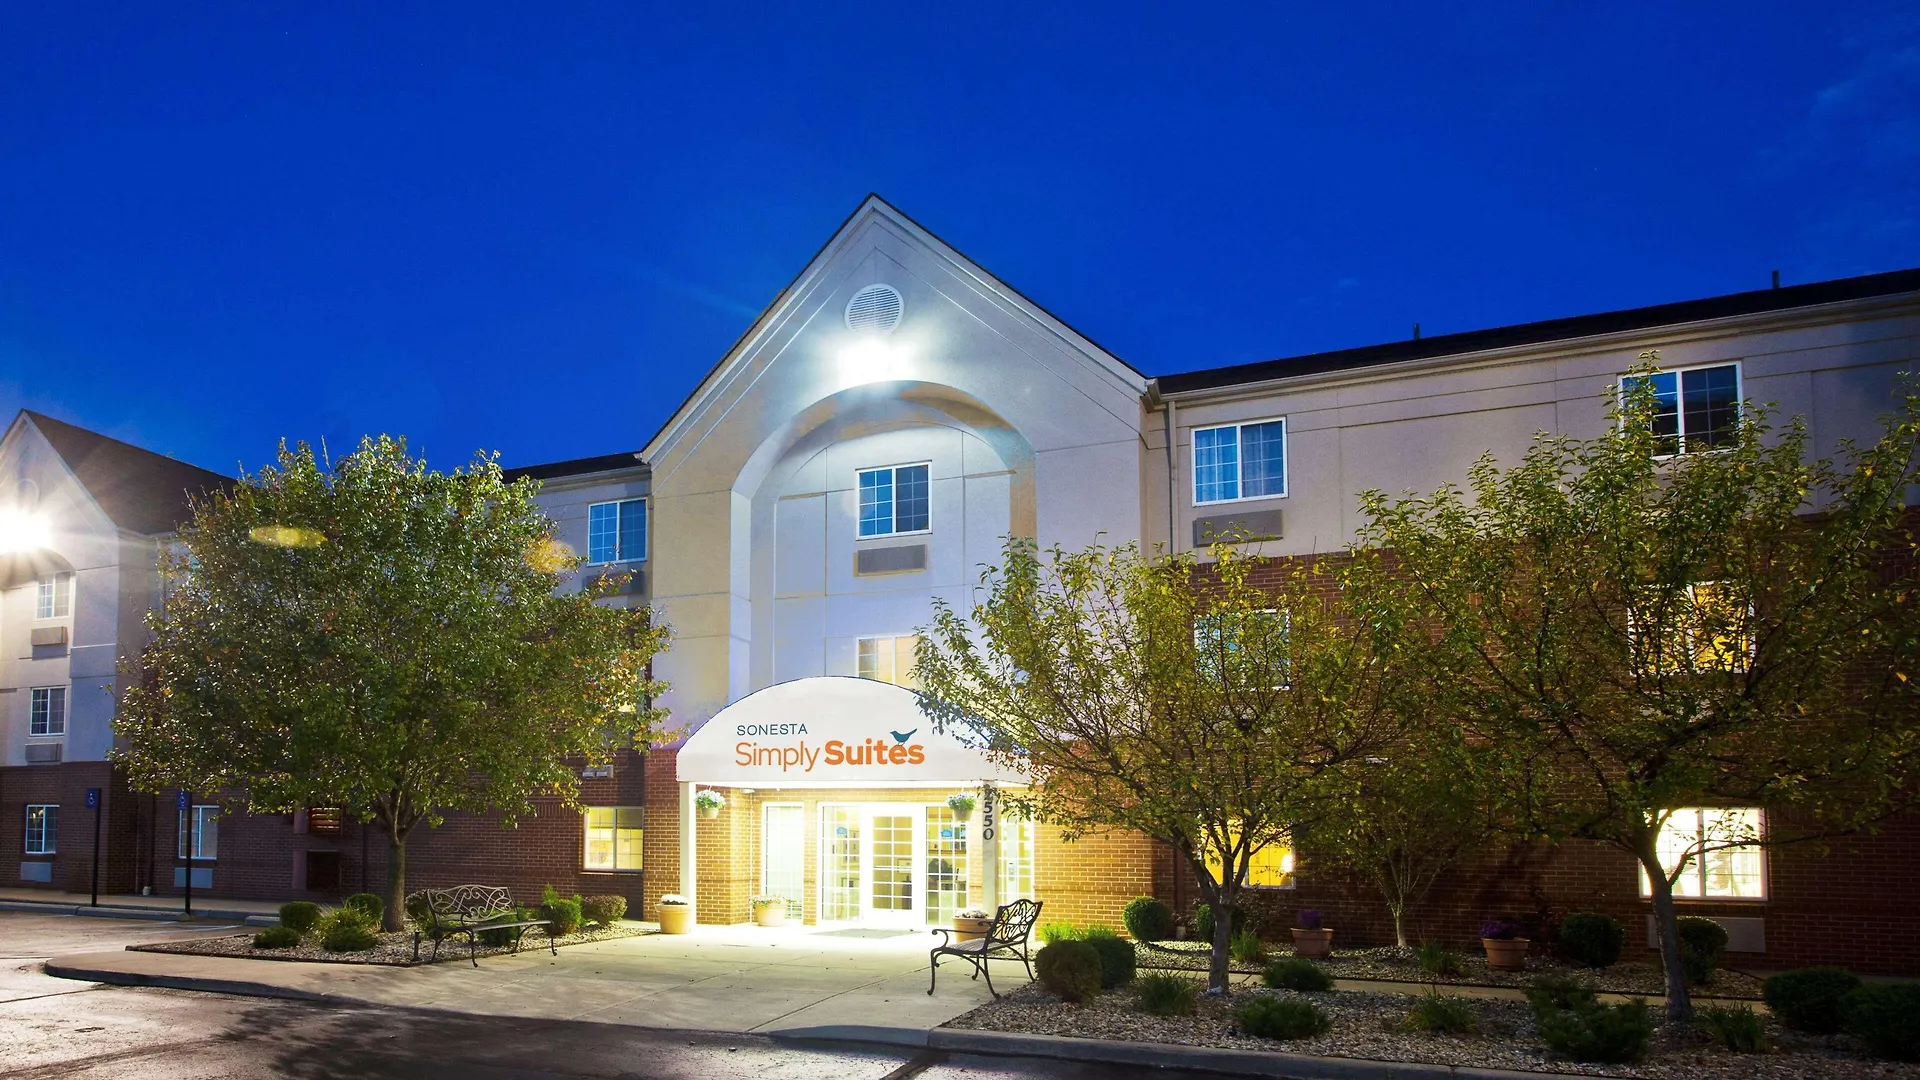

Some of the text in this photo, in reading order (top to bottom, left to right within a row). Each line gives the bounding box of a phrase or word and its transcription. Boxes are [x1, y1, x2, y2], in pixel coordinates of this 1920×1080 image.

[736, 723, 808, 736] SONESTA
[735, 738, 925, 772] Simply Suites
